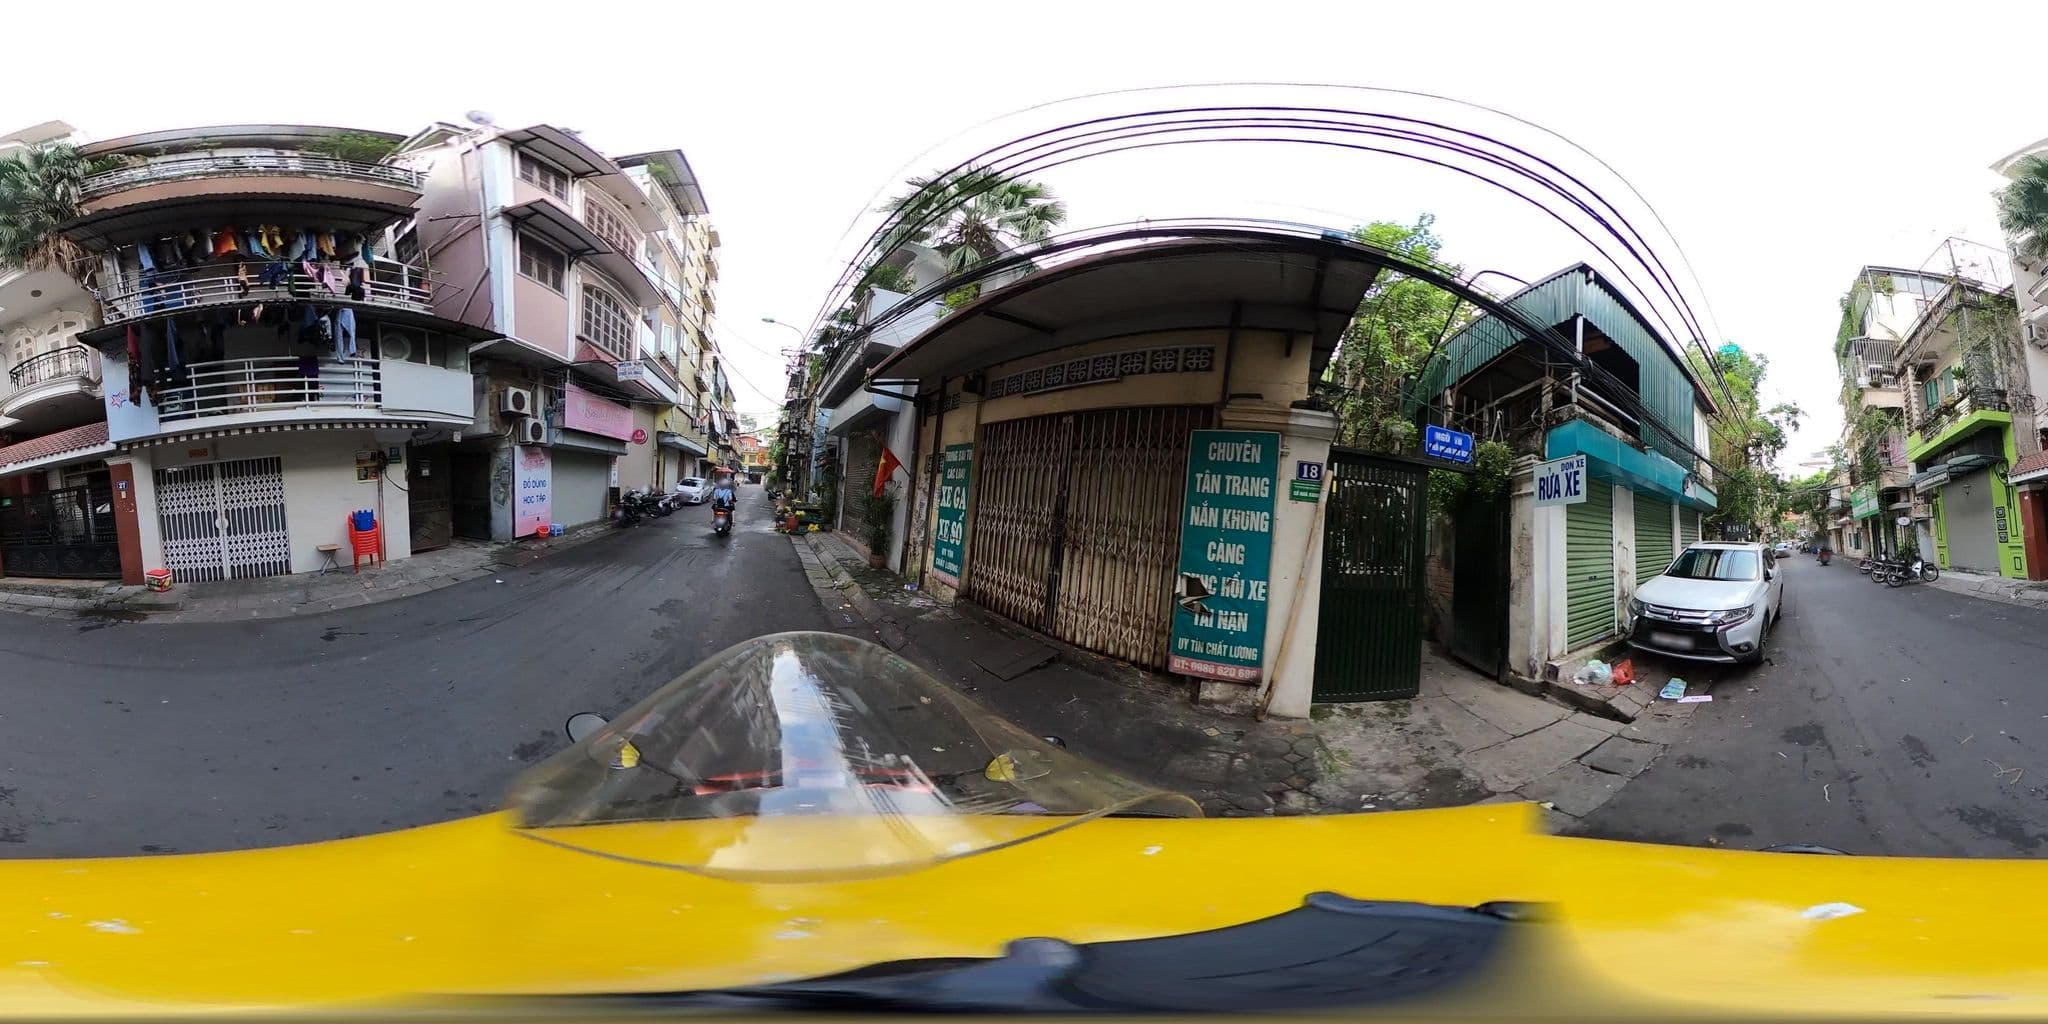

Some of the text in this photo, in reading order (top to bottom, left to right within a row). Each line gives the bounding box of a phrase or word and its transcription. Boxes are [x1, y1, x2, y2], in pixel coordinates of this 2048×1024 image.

[1208, 440, 1262, 463] CHUYÊN
[1575, 458, 1585, 469] XE
[1195, 469, 1221, 494] TÂN
[1224, 475, 1270, 498] TRANG
[1302, 464, 1319, 479] 18
[1538, 466, 1581, 501] RỬA XE
[940, 485, 967, 510] XE GA
[937, 511, 963, 546] XE SỐ
[1189, 500, 1270, 533] NẮN KHUNG
[1206, 537, 1246, 566] CÀNG
[1247, 580, 1268, 602] XE
[1217, 610, 1249, 636] NẠN
[1177, 637, 1258, 662] UY TÍN CHẤT LƯỢNG
